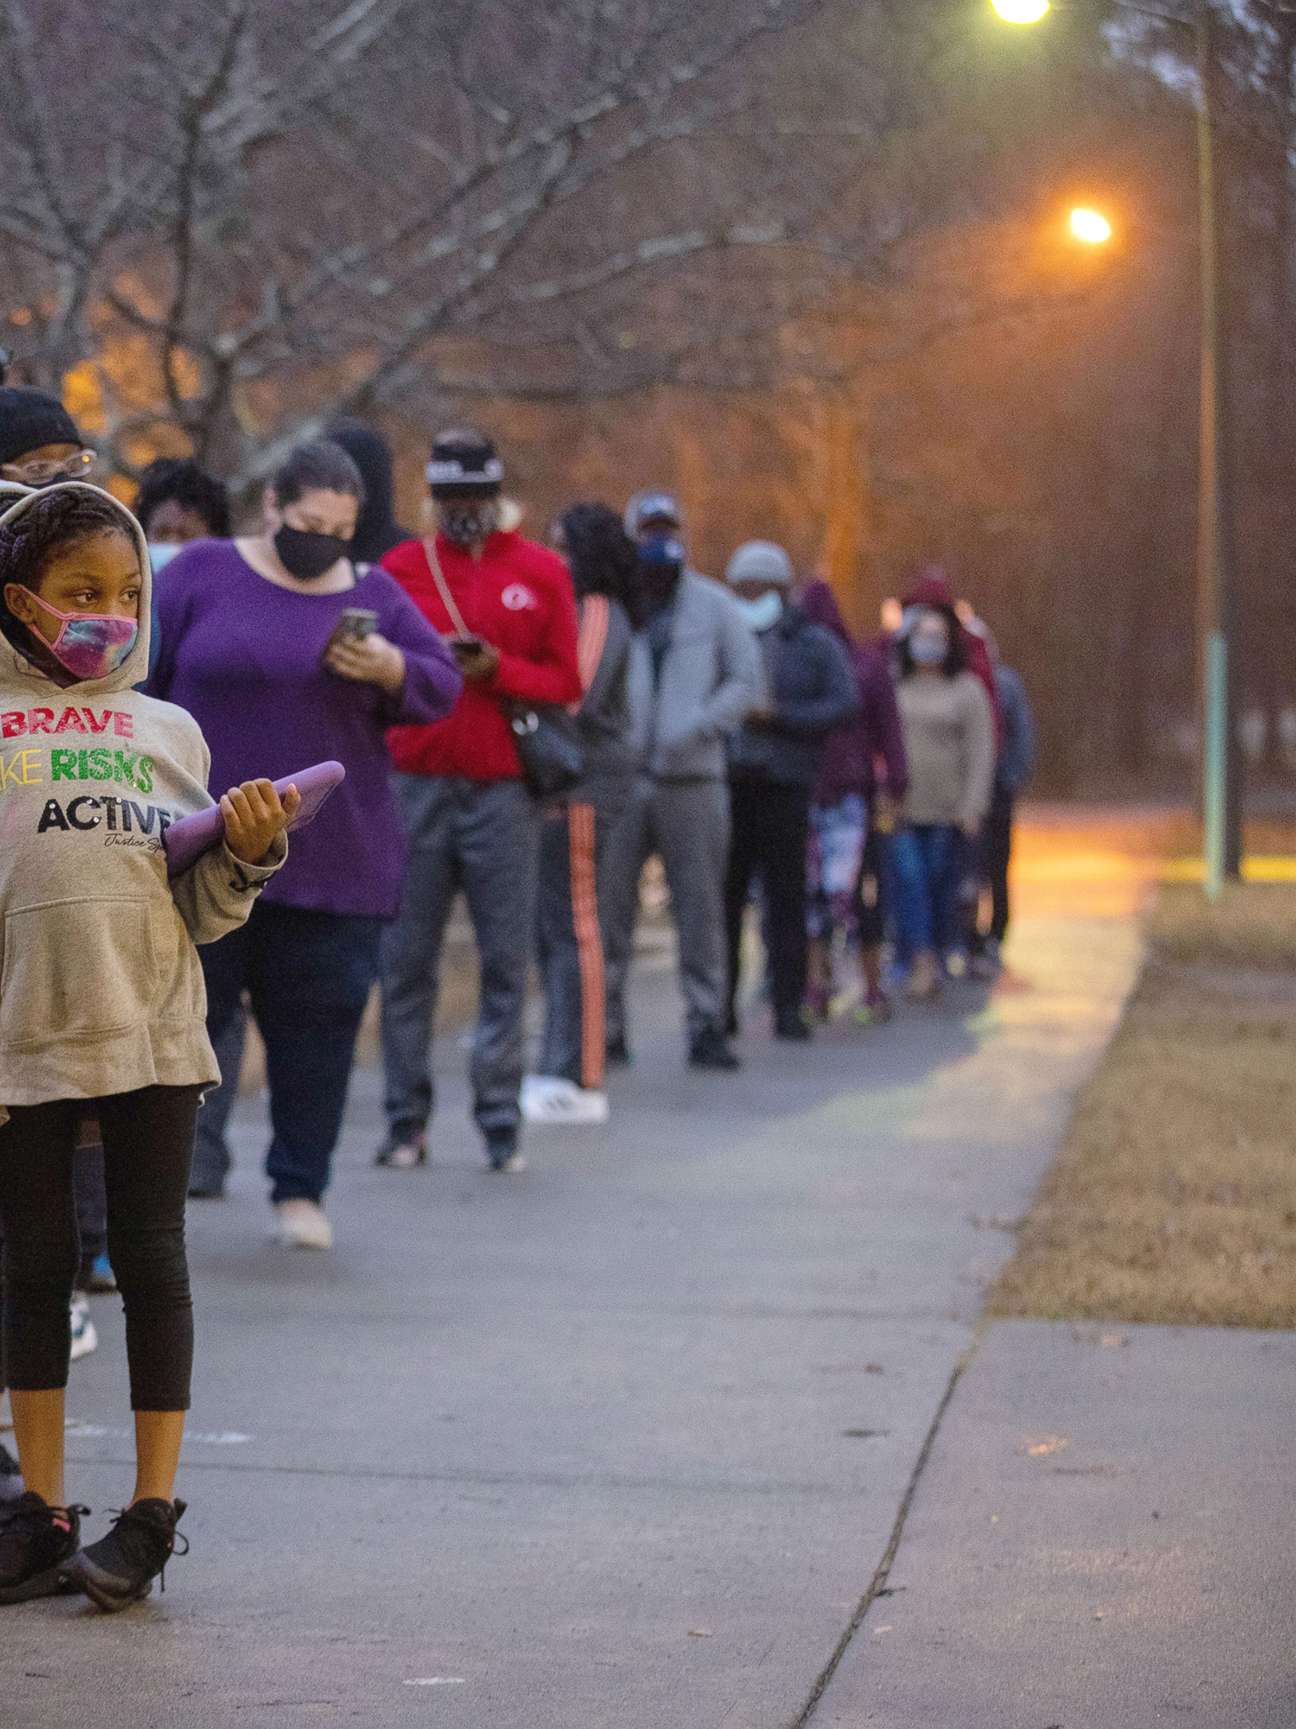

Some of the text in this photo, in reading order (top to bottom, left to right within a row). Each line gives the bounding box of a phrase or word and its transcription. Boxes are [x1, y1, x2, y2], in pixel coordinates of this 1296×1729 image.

[0, 706, 136, 738] BRAVE
[50, 747, 154, 793] RISKS
[104, 833, 146, 848] Justice
